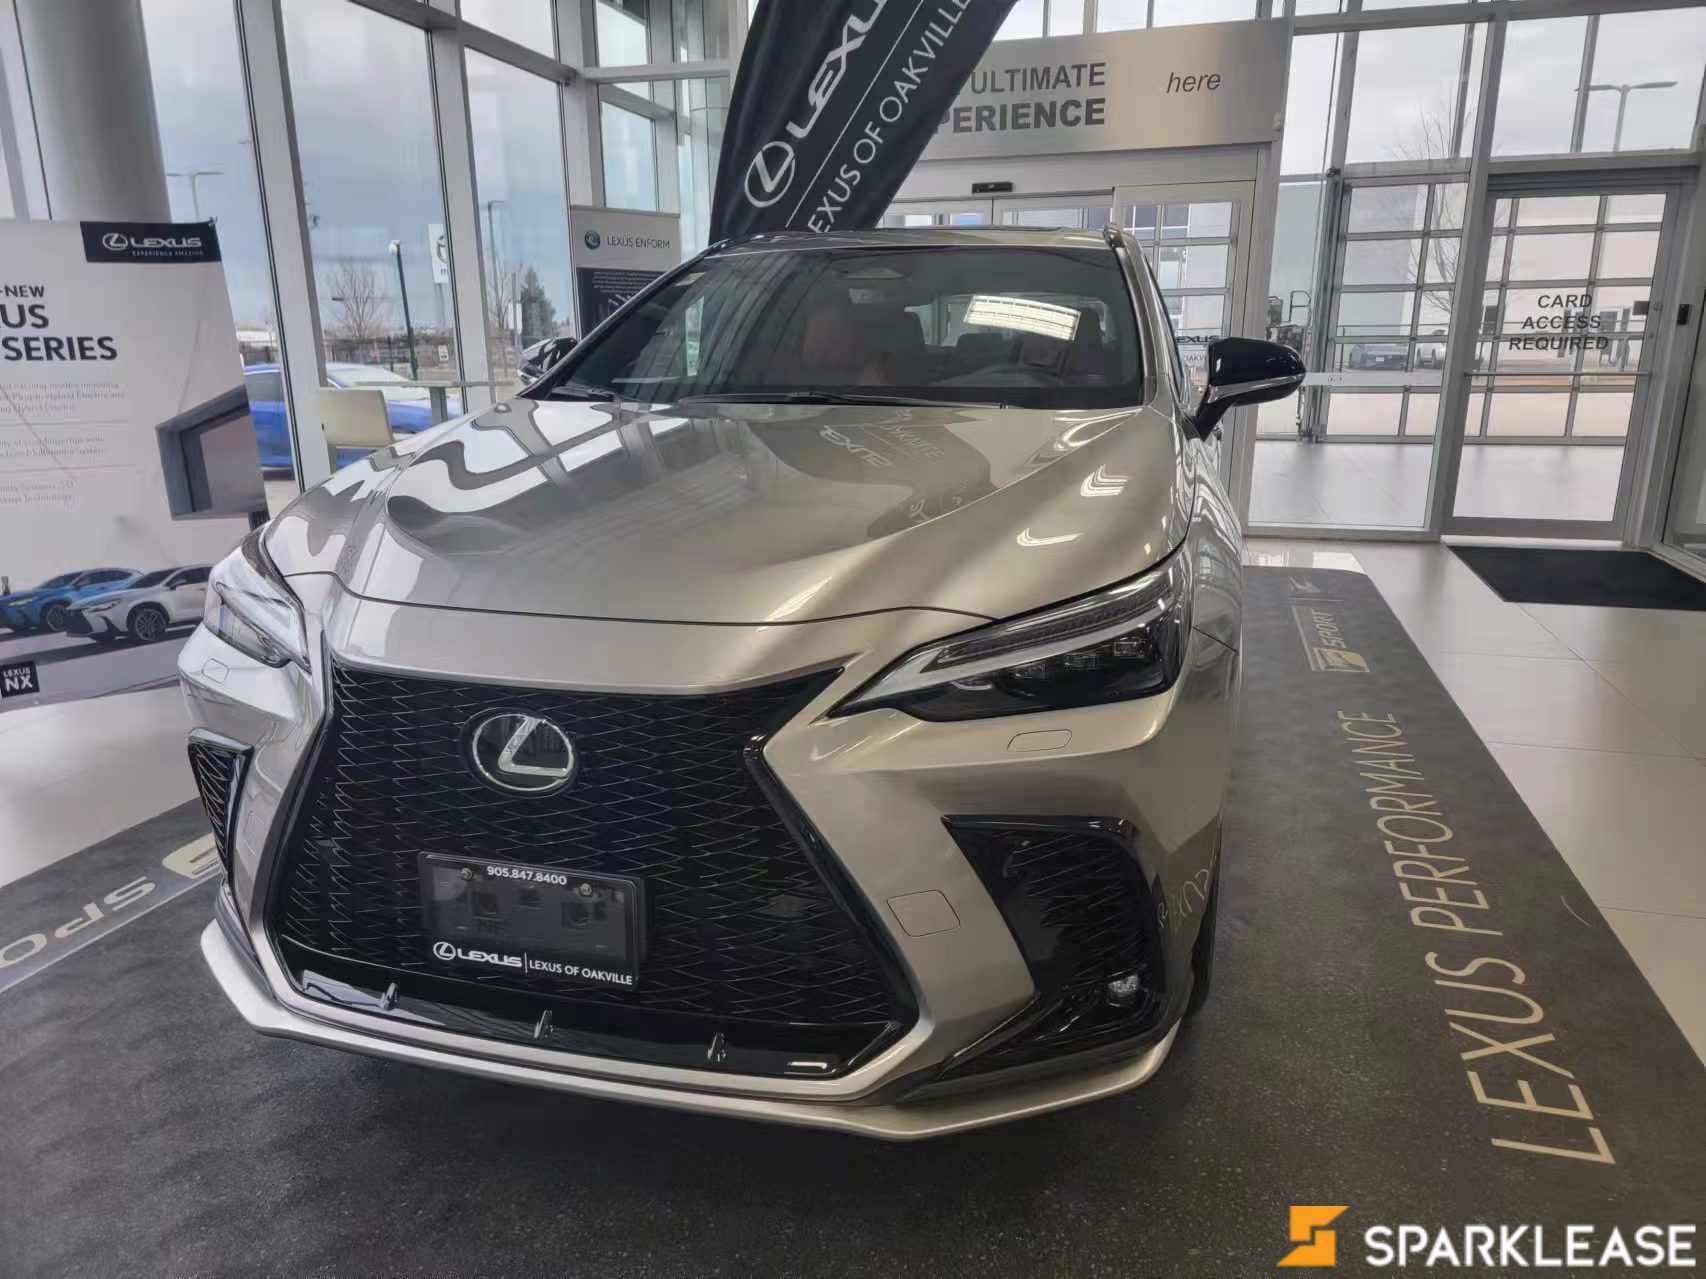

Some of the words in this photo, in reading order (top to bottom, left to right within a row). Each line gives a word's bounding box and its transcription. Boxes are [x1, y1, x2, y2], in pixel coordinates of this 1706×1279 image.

[971, 62, 1106, 94] ULTIMATE
[1167, 71, 1222, 93] here
[853, 121, 884, 164] OF
[130, 236, 202, 249] LEXUS
[607, 235, 634, 248] LEXUS
[636, 239, 670, 249] ENFORM
[1538, 294, 1593, 309] CARD
[0, 303, 49, 329] US
[1521, 316, 1601, 330] ACCESS
[2, 335, 118, 361] SERIES
[1509, 336, 1609, 350] REQUIRED
[3, 667, 31, 678] LEXUS
[4, 675, 33, 692] NX
[1337, 710, 1504, 937] PERFORMANCE
[486, 866, 568, 885] 905.847.8400
[457, 948, 523, 968] LEXUS
[529, 959, 562, 974] LEXUS
[564, 965, 580, 976] OF
[581, 968, 633, 986] OAKVILLE
[1425, 951, 1617, 1165] LEXUS
